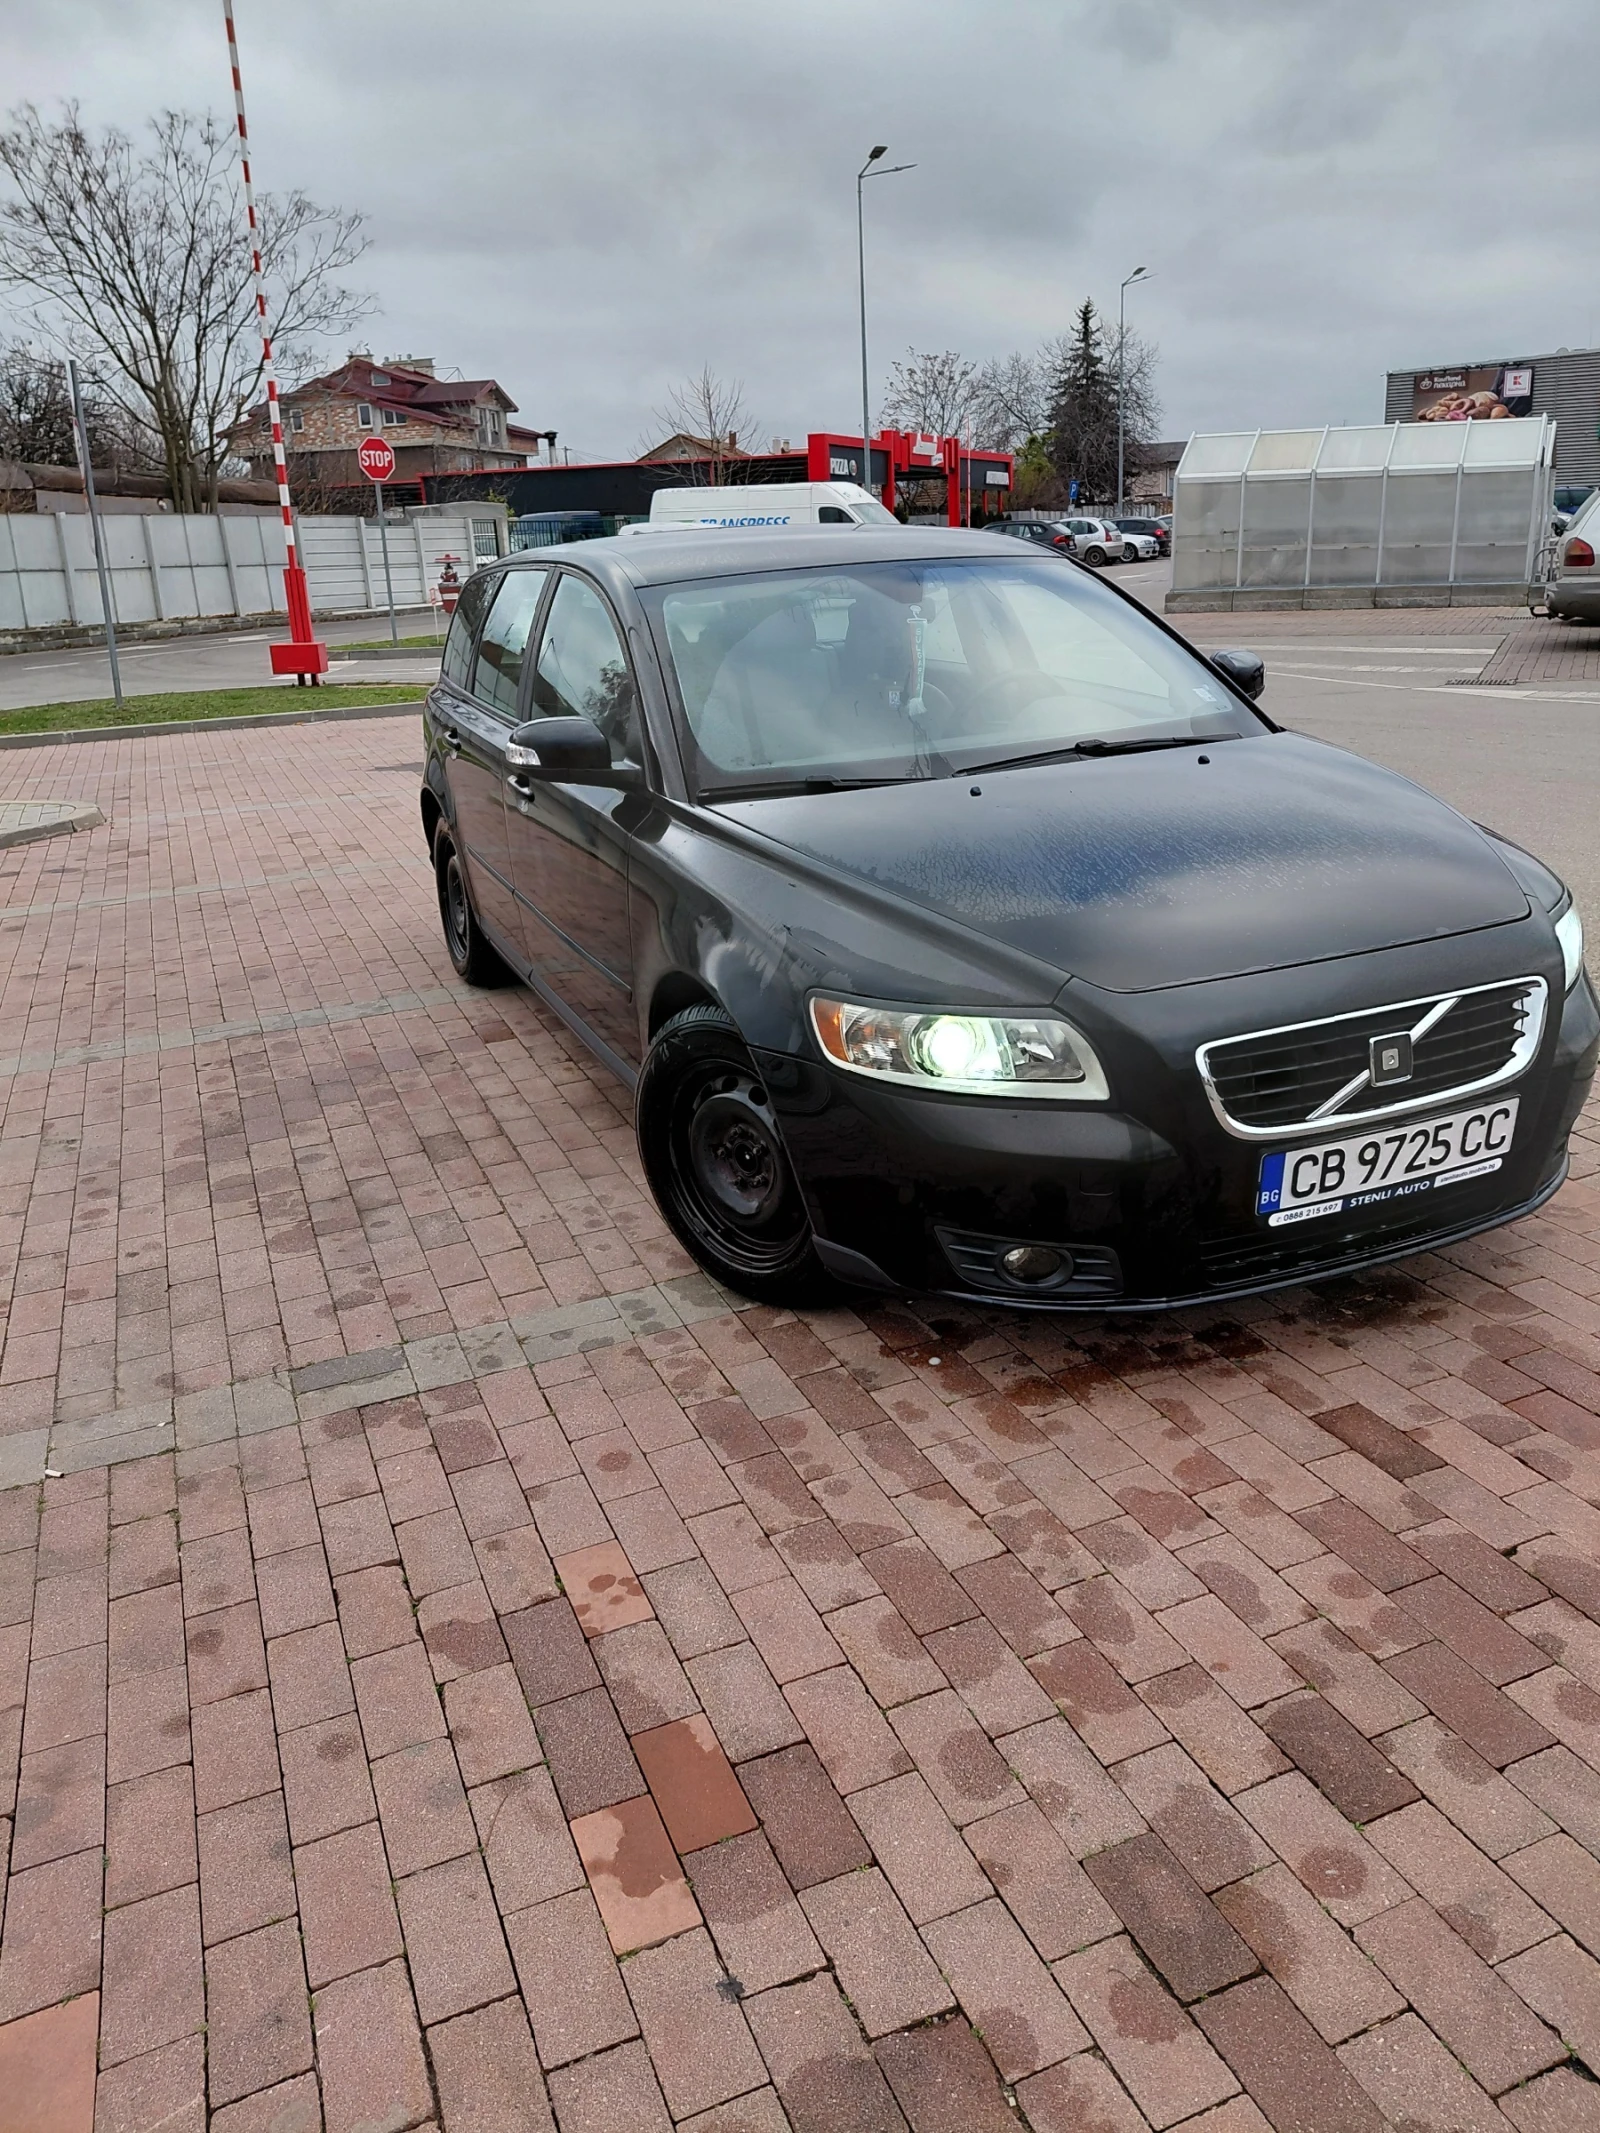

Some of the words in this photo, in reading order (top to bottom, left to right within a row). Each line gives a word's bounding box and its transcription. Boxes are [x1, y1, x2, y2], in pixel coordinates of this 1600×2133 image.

[361, 449, 391, 467] STOP
[829, 457, 850, 476] PIZZA
[1070, 483, 1077, 496] P
[1290, 1148, 1346, 1199] CB
[1357, 1121, 1454, 1186] 9725
[1460, 1107, 1510, 1158] CC
[1260, 1189, 1280, 1205] BG
[1349, 1189, 1391, 1207] STENLI
[1394, 1181, 1430, 1197] AUTO
[1283, 1210, 1304, 1222] 0888
[1305, 1206, 1321, 1217] 215
[1322, 1203, 1338, 1213] 697
